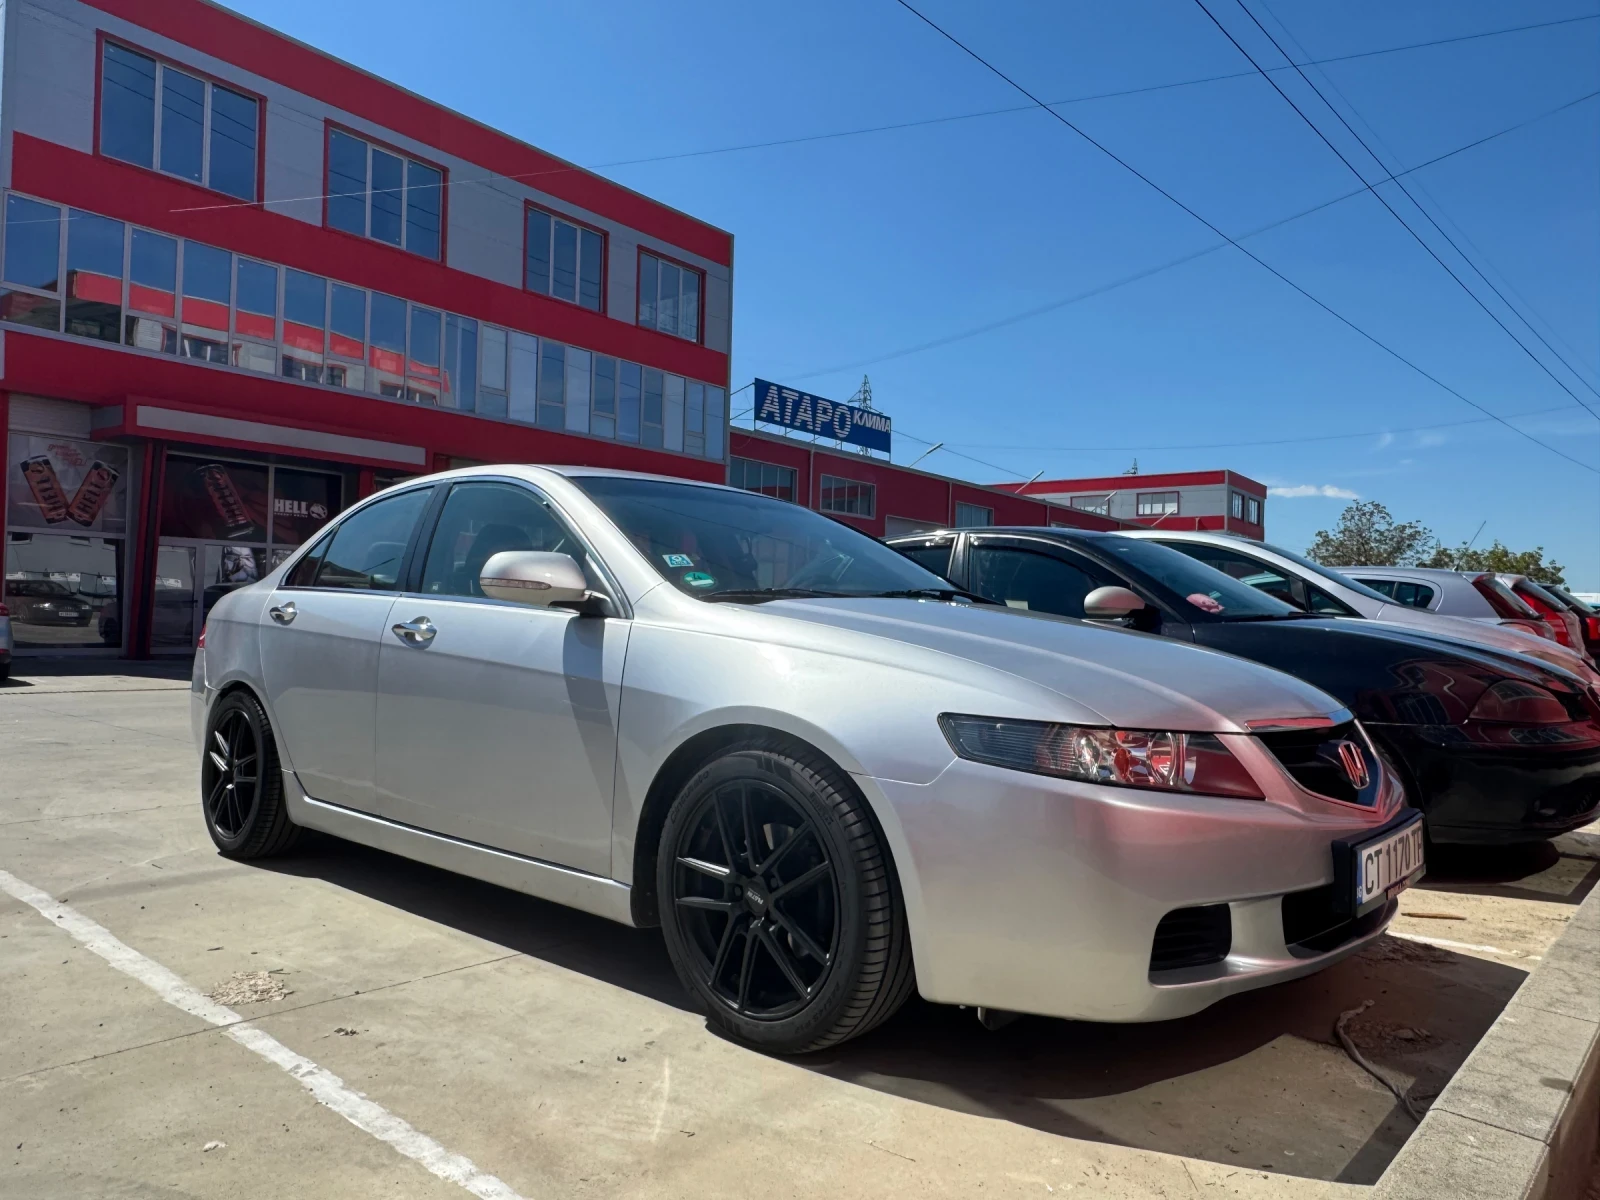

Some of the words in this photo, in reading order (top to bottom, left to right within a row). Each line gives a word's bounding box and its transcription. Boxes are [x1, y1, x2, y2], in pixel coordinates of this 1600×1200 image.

[760, 385, 851, 438] АТАРО
[853, 410, 891, 433] КЛИМА
[76, 481, 105, 514] HELL
[274, 498, 308, 514] HELL
[1365, 848, 1382, 895] CT
[1386, 833, 1411, 884] 1170
